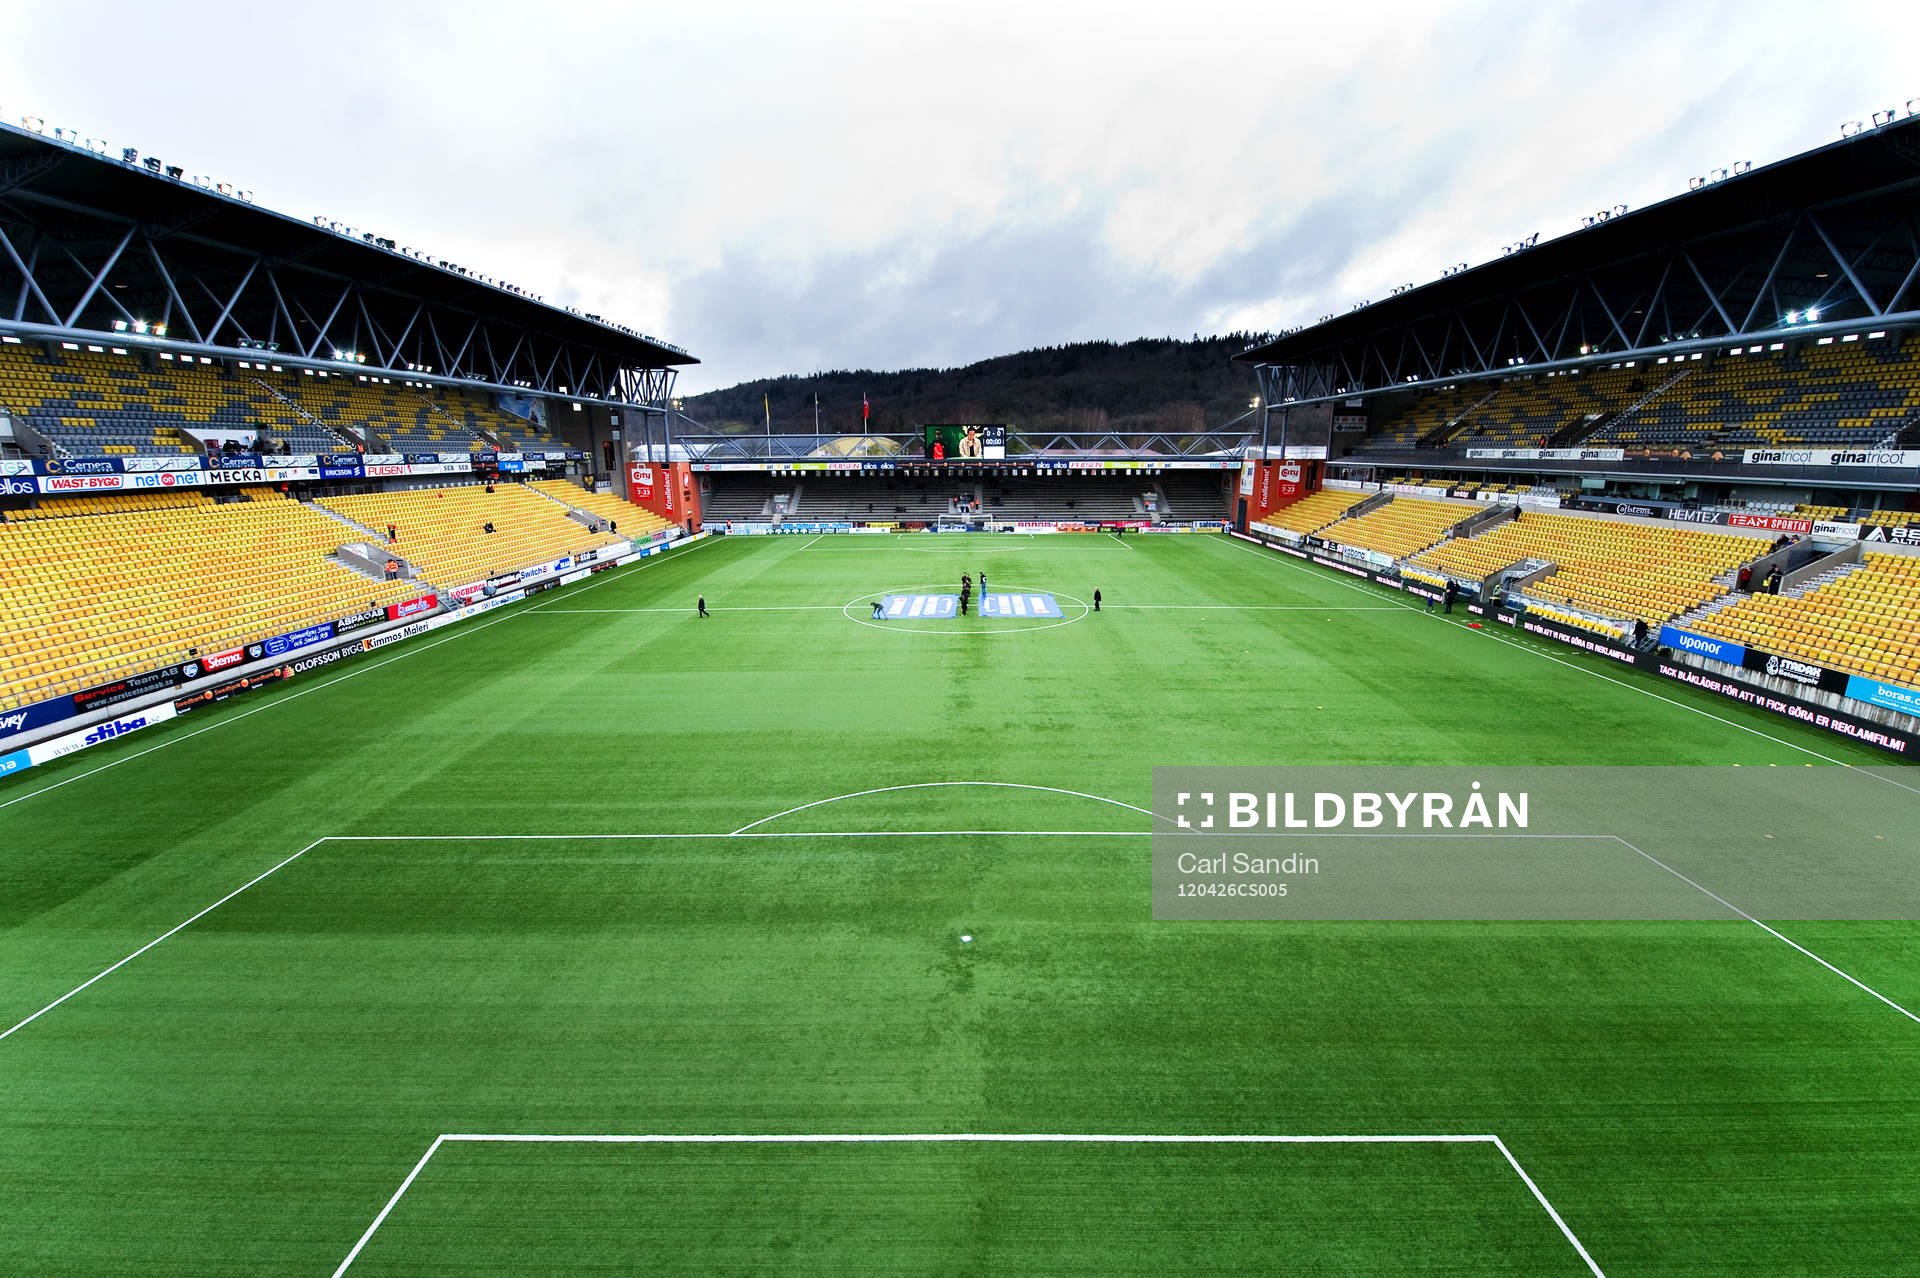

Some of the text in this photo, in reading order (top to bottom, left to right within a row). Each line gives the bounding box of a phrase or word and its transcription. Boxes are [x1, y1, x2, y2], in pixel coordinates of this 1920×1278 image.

[64, 459, 112, 470] Cernera
[325, 468, 352, 476] ERICSSON
[368, 465, 403, 475] PULSEN
[1281, 468, 1299, 477] City
[210, 470, 261, 482] MECKA
[1668, 508, 1720, 524] HEMTEX
[1731, 515, 1809, 531] TEAM SPORTIA
[366, 632, 402, 649] Kimmos
[1680, 635, 1722, 655] uponor
[294, 650, 341, 673] OLOFSSON
[73, 667, 179, 703] Service Team AB
[1659, 664, 1906, 752] TACK BLÅKLÄDER FÖR ATT VI FICK GÖRA ER REKLAMFILM!
